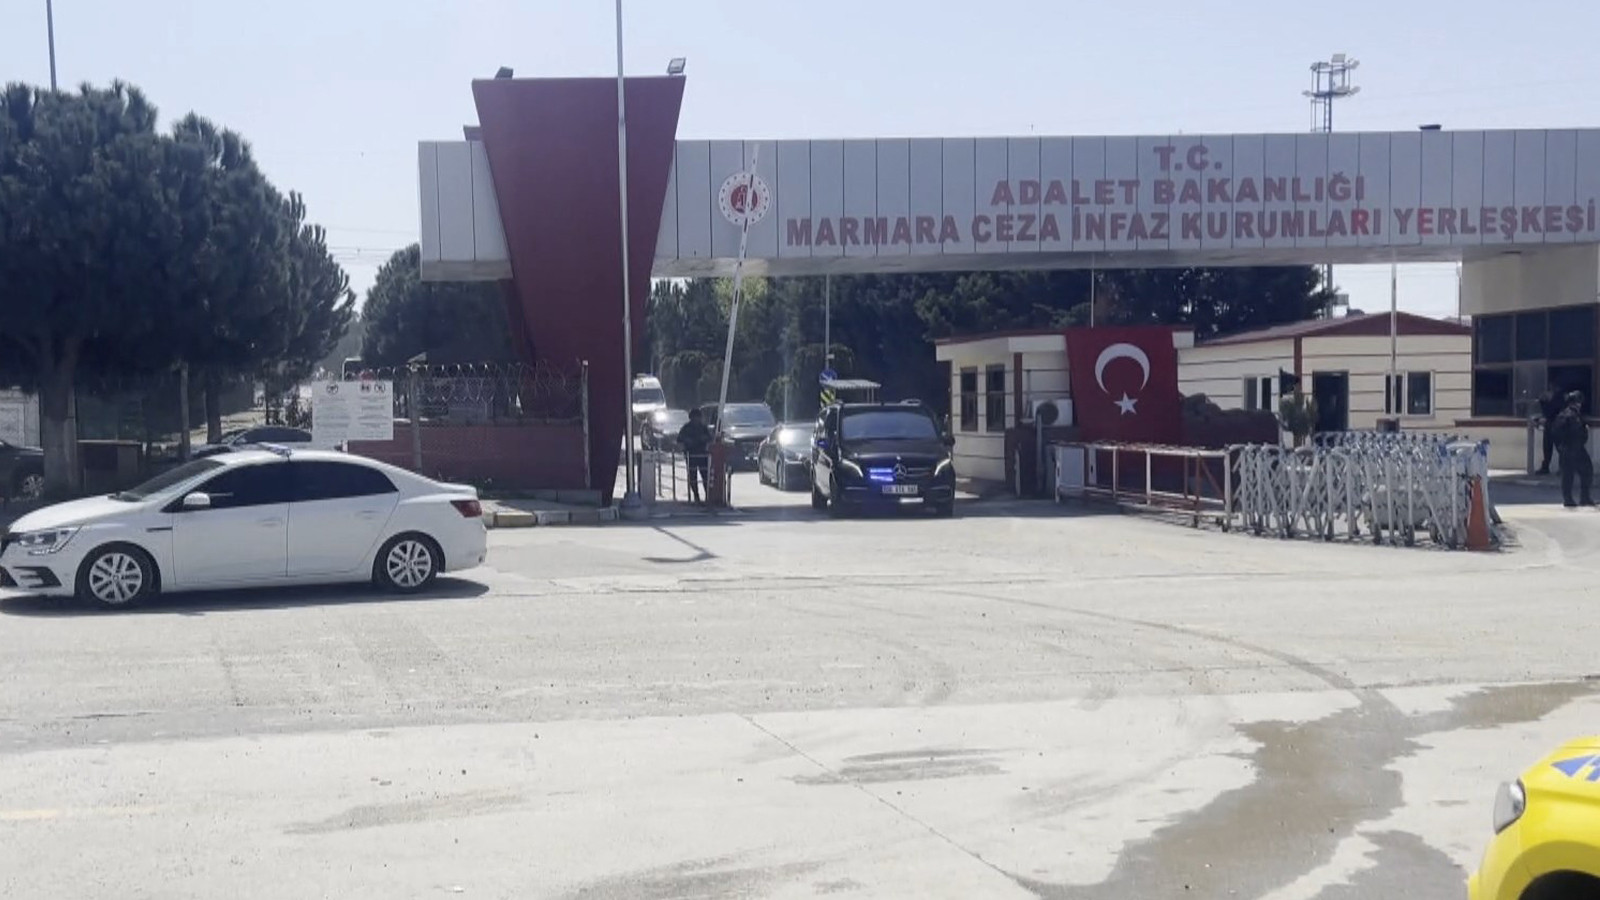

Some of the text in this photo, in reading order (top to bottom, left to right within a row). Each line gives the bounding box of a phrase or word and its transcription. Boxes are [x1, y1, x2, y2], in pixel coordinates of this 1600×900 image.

[1153, 144, 1223, 171] T.C.
[990, 171, 1365, 206] ADALET BAKANLIĞI
[786, 198, 1596, 247] MARMARA CEZA İNFAZ KURUMLARI YERLEŞKESİ
